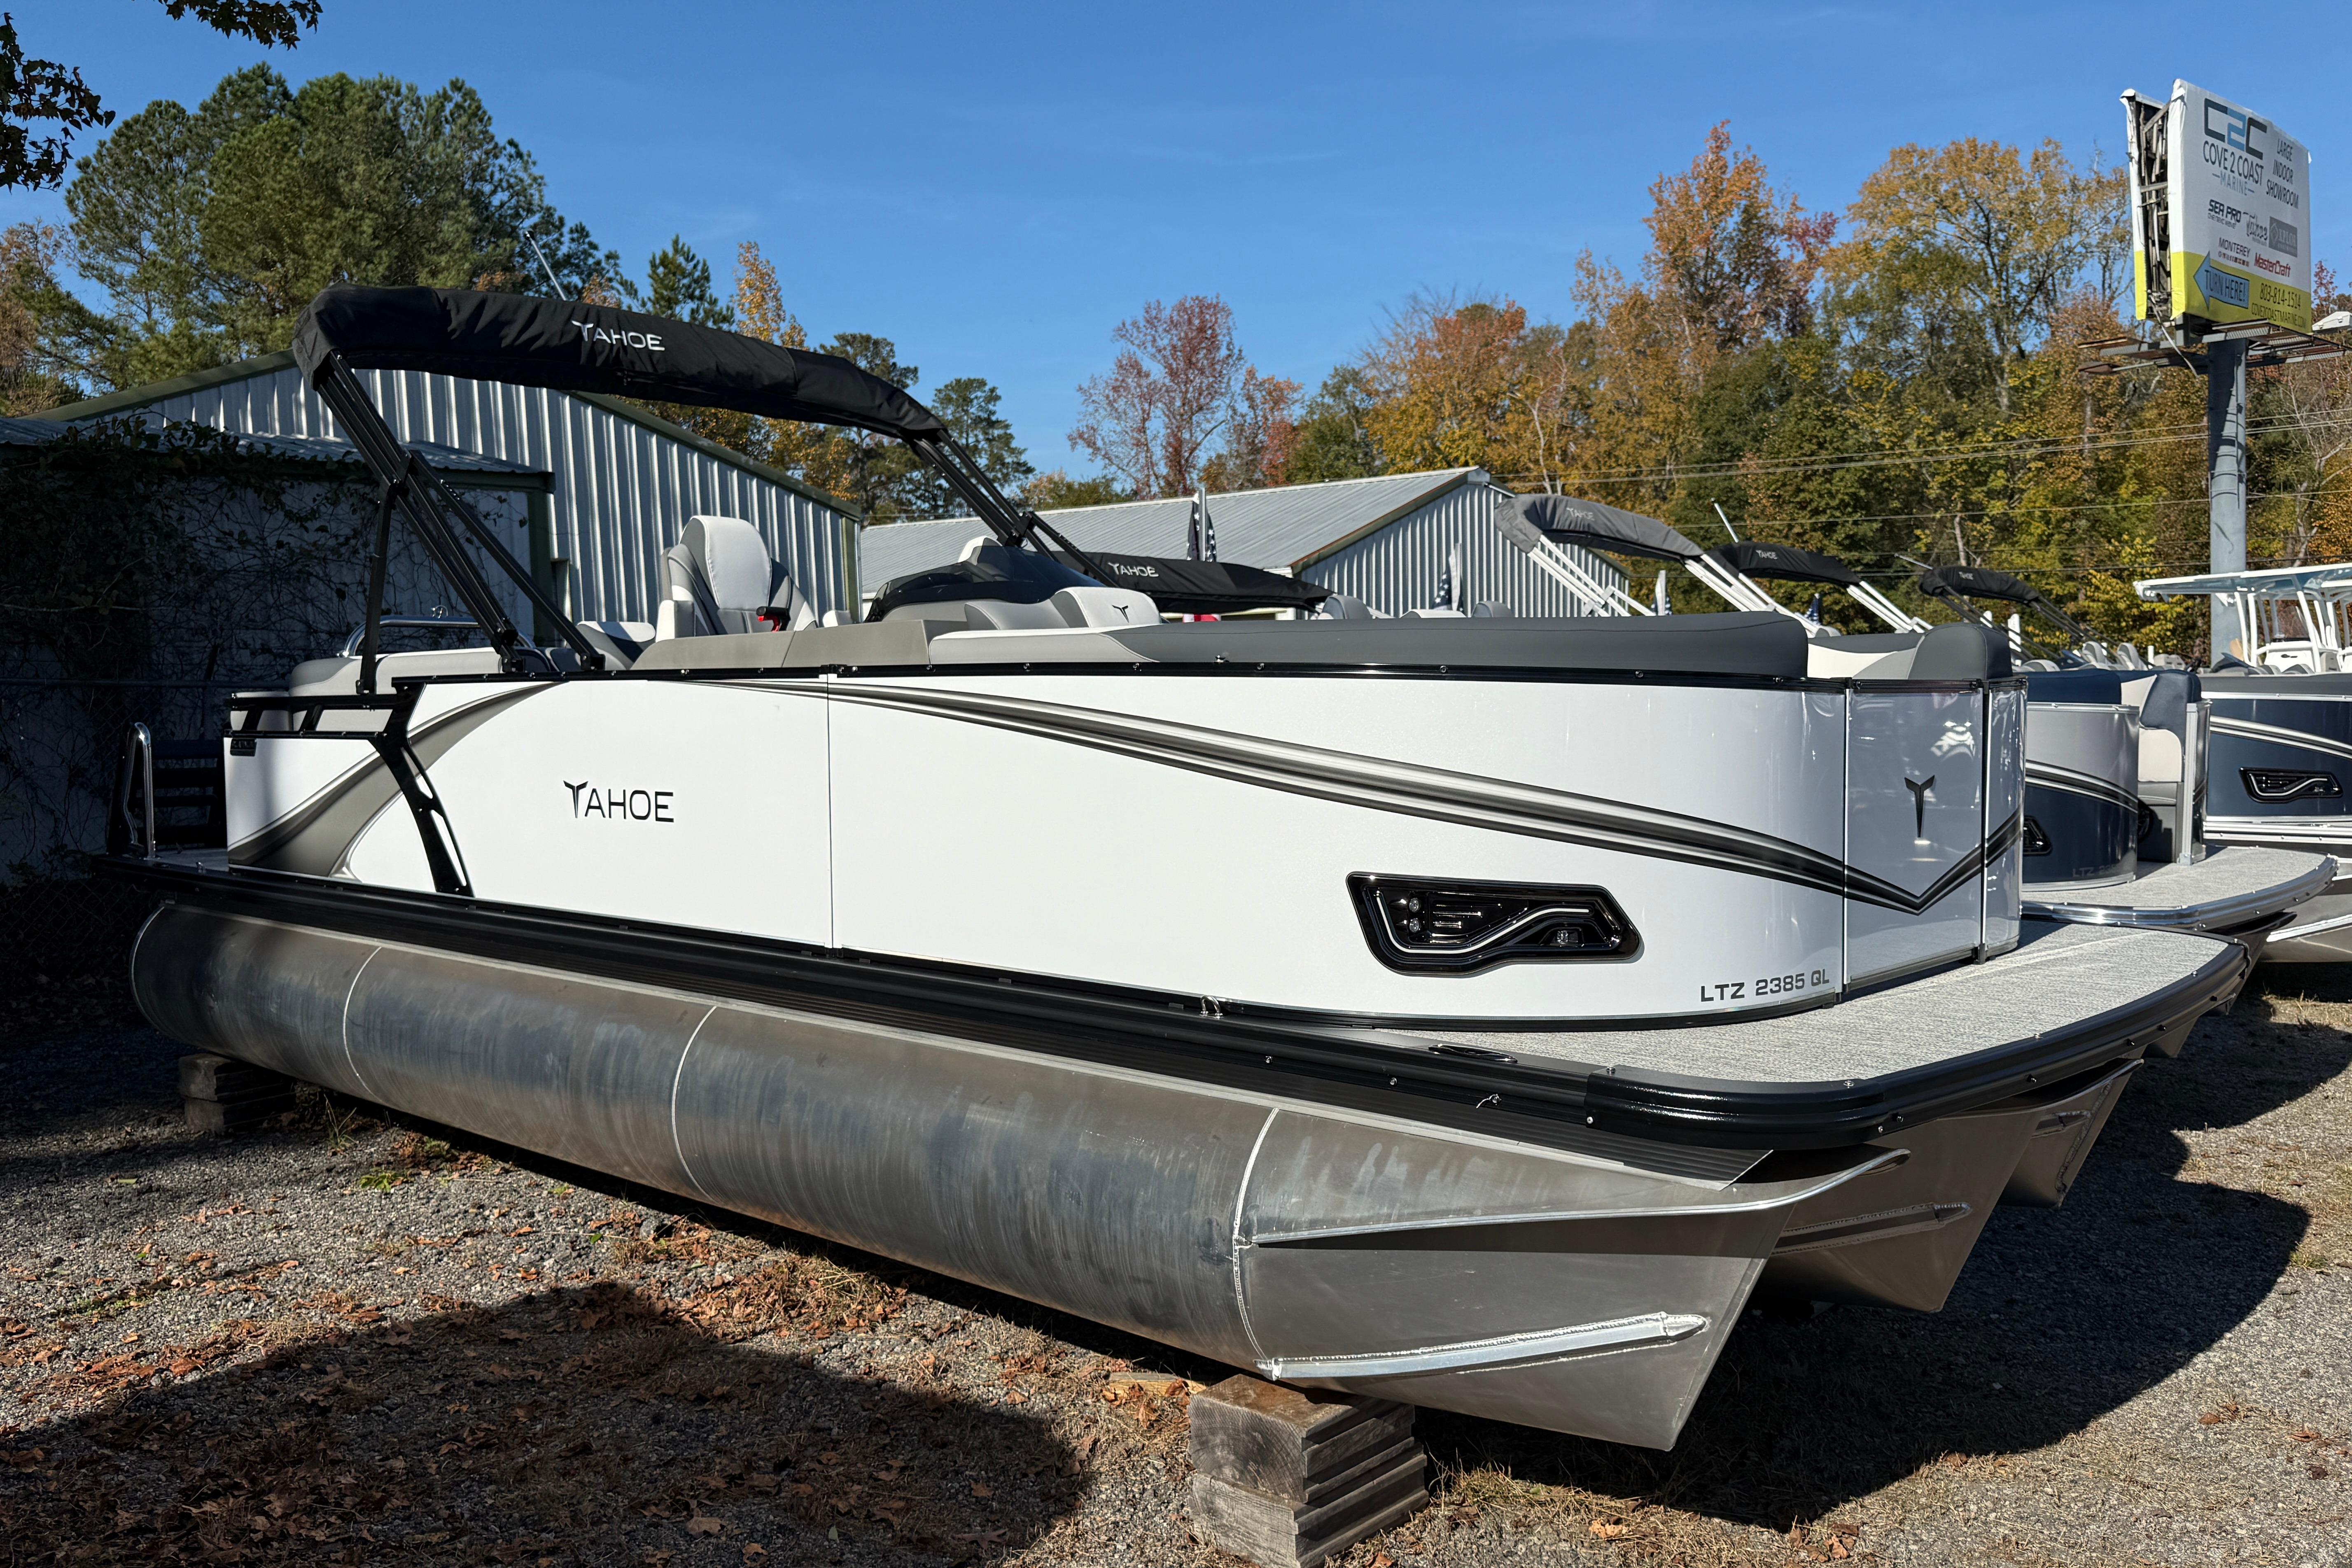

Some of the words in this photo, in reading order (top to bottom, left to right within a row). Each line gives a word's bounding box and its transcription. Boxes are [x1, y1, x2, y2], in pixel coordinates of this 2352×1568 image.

[2203, 140, 2228, 171] COVE
[2230, 151, 2235, 174] 2
[2237, 155, 2264, 186] COAST
[2277, 138, 2293, 162] LARGE
[2220, 170, 2247, 196] MARINE
[2273, 159, 2294, 185] INDOOR
[2266, 179, 2299, 209] SHOWROOM
[2208, 199, 2225, 217] SEA
[2226, 206, 2242, 223] PRO
[2219, 237, 2251, 258] MONTEREY
[2254, 252, 2291, 278] MasterCraft
[2205, 269, 2224, 295] TURN
[2225, 278, 2245, 303] HERE!
[2260, 282, 2301, 310] 803-814-1514
[571, 320, 665, 351] TAHOE
[1108, 562, 1159, 577] TAHOE
[563, 780, 674, 823] TAHOE
[2072, 867, 2094, 877] LTZ
[1701, 982, 1745, 1002] LTZ
[1755, 973, 1805, 996] 2385
[1811, 968, 1830, 987] QL
